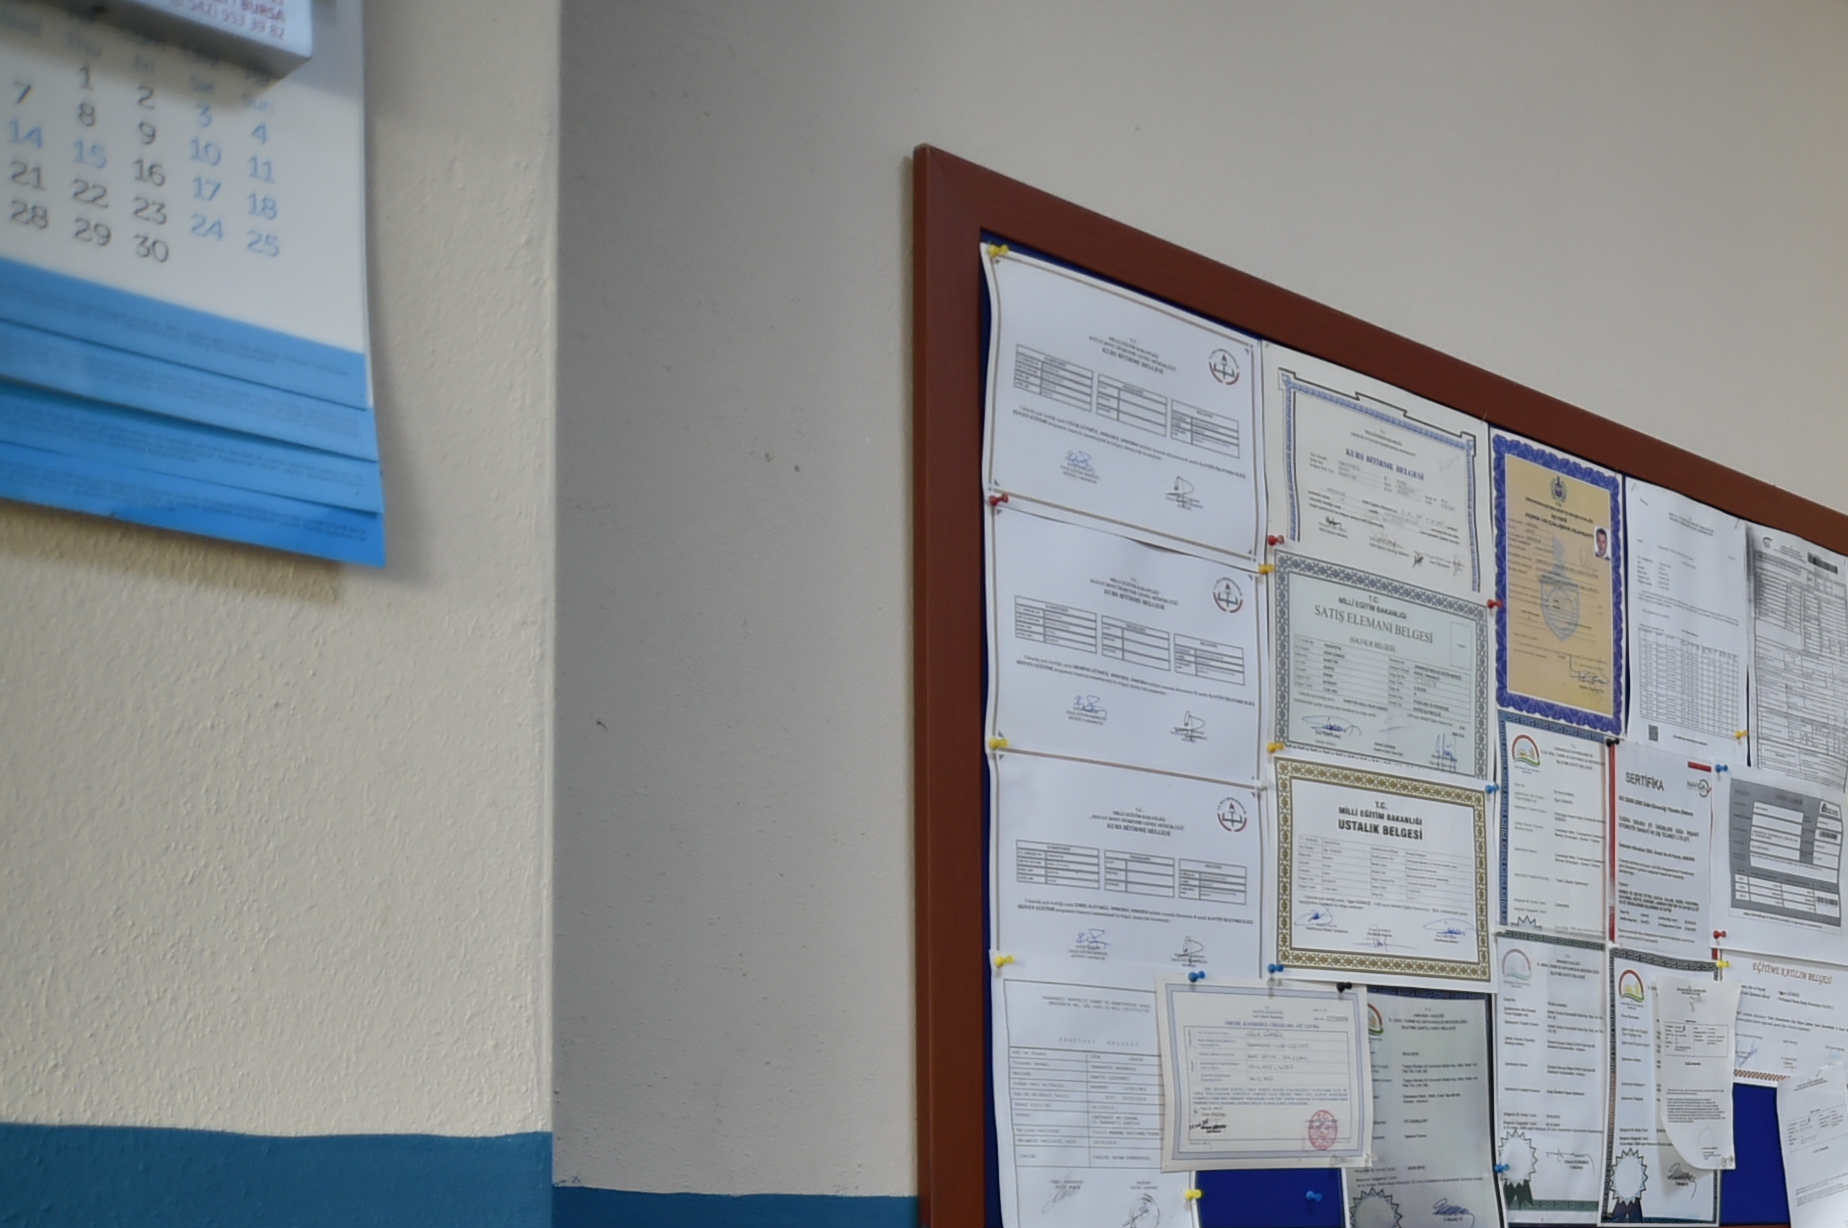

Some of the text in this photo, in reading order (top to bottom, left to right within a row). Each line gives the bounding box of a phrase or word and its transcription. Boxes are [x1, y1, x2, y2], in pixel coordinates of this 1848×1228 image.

[13, 80, 276, 184] 7 8 9 10 11
[77, 66, 269, 145] 1 2 3 4
[8, 117, 278, 221] 14 15 16 17 18
[9, 159, 281, 258] 21 22 23 24 25
[9, 199, 170, 264] 28 29 30
[1345, 448, 1365, 461] KURS
[1314, 604, 1434, 645] SATIŞ ELEMANI BELGESİ
[1625, 771, 1665, 792] SERTİFİKA
[1338, 818, 1423, 841] USTALIK BELGESİ
